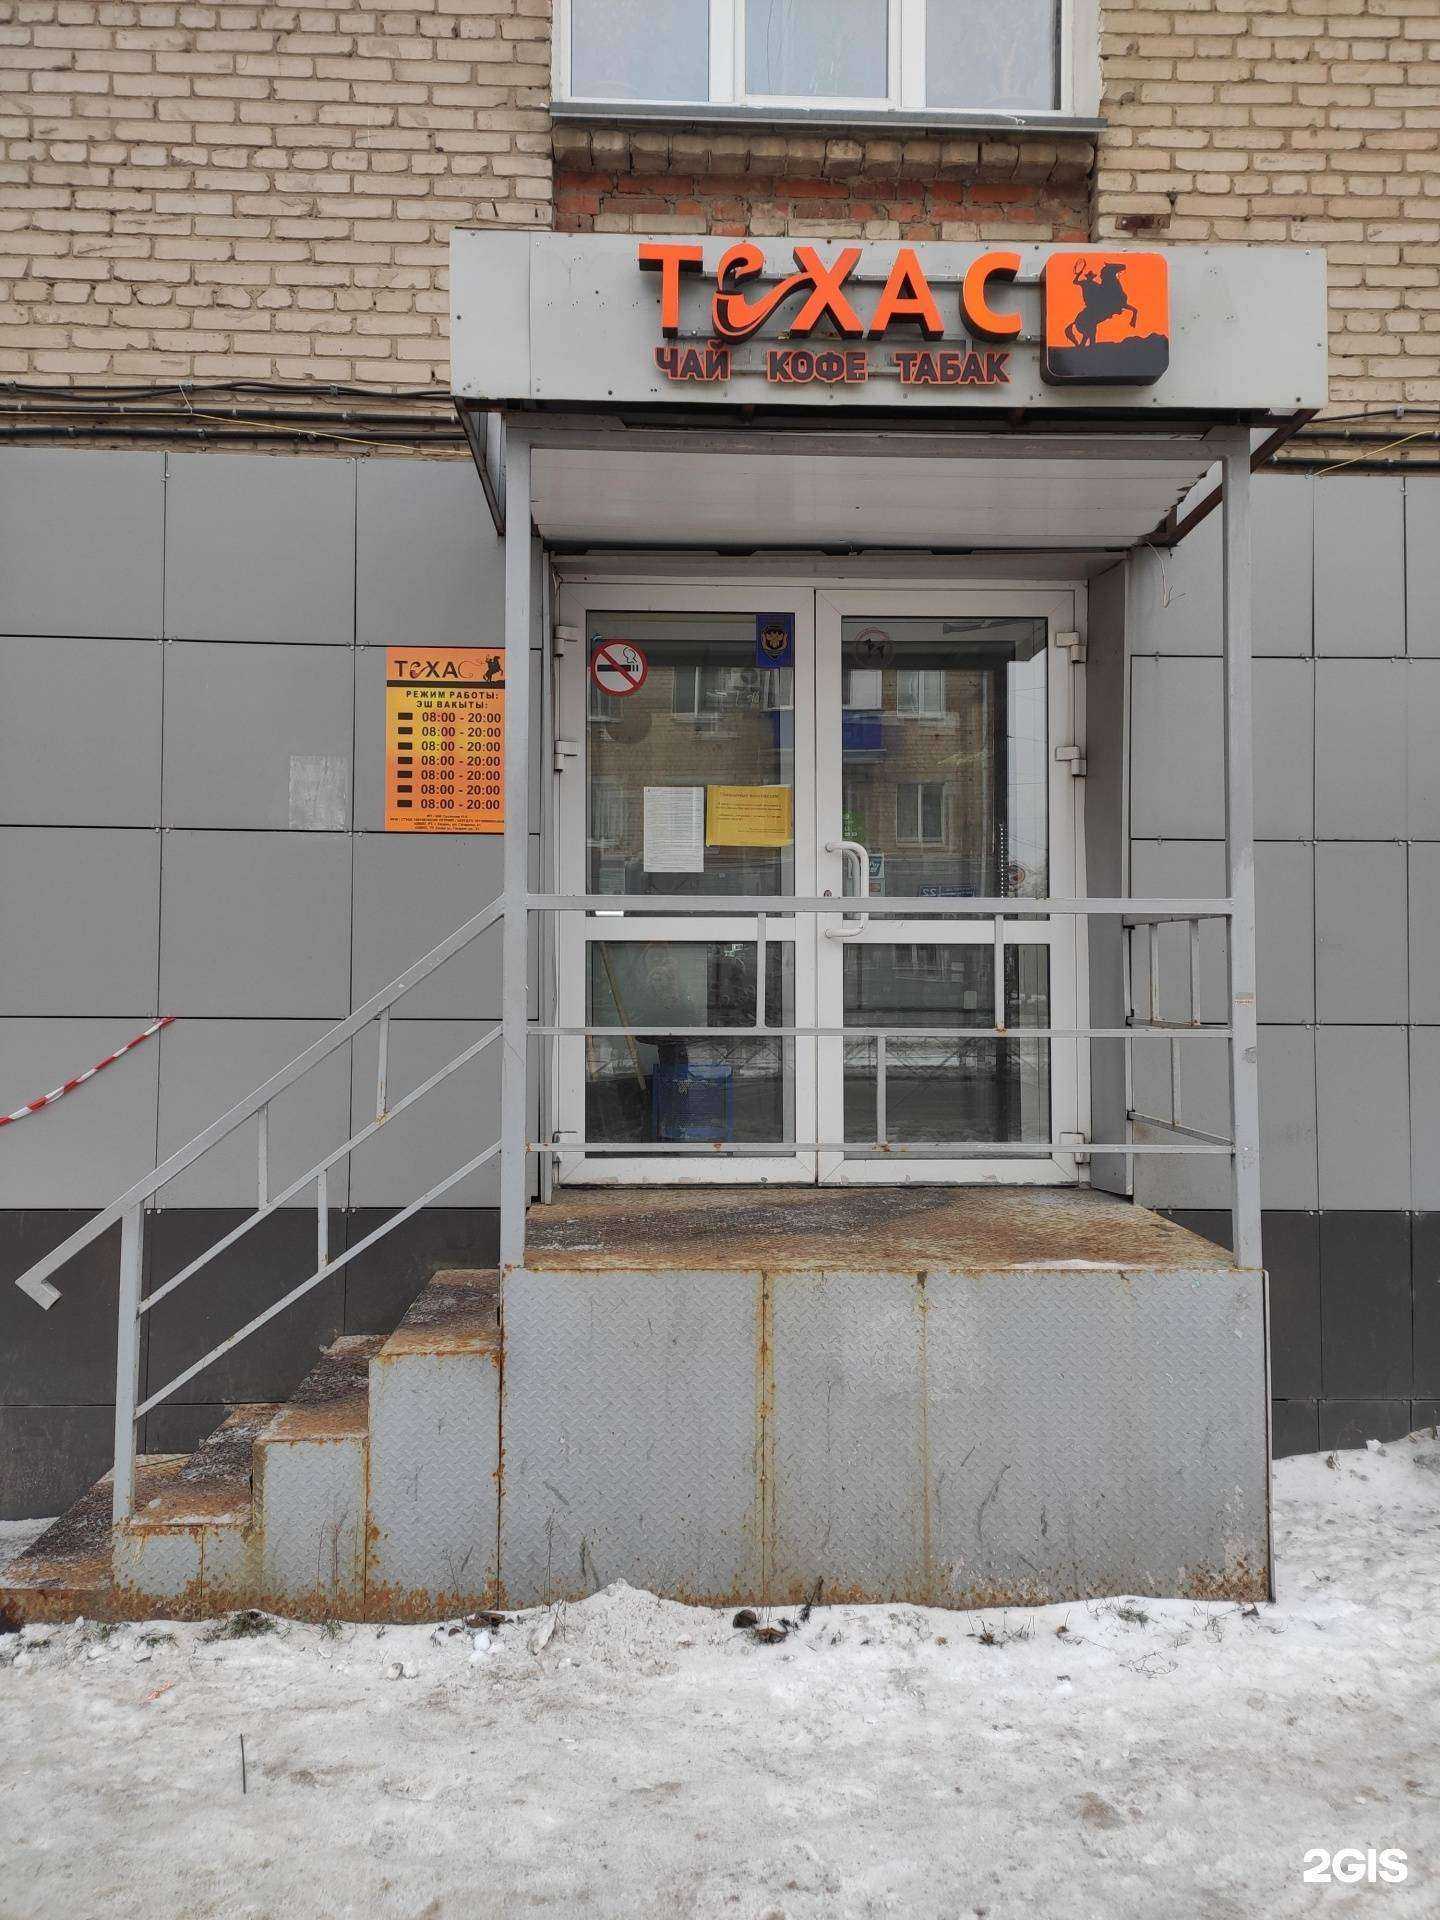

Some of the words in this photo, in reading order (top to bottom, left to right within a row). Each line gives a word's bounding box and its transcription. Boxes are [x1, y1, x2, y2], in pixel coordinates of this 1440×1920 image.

[653, 338, 731, 382] ЧАЙ
[767, 350, 868, 383] КОФЕ
[892, 350, 1011, 385] ТАБАК
[450, 691, 499, 699] РАБОТЫ:
[437, 701, 488, 709] ВАКЫТЫ:
[422, 712, 456, 722] 08:00
[468, 713, 501, 723] 20:00
[422, 727, 455, 737] 08:00
[467, 727, 501, 737] 20:00
[422, 741, 455, 751] 08:00
[467, 742, 501, 752] 20:00
[421, 756, 455, 765] 08:00
[467, 756, 500, 766] 20:00
[421, 770, 455, 780] 08:00
[467, 771, 500, 781] 20:00
[421, 785, 454, 794] 08:00
[466, 785, 500, 795] 20:00
[421, 799, 454, 809] 08:00
[466, 800, 500, 810] 20:00
